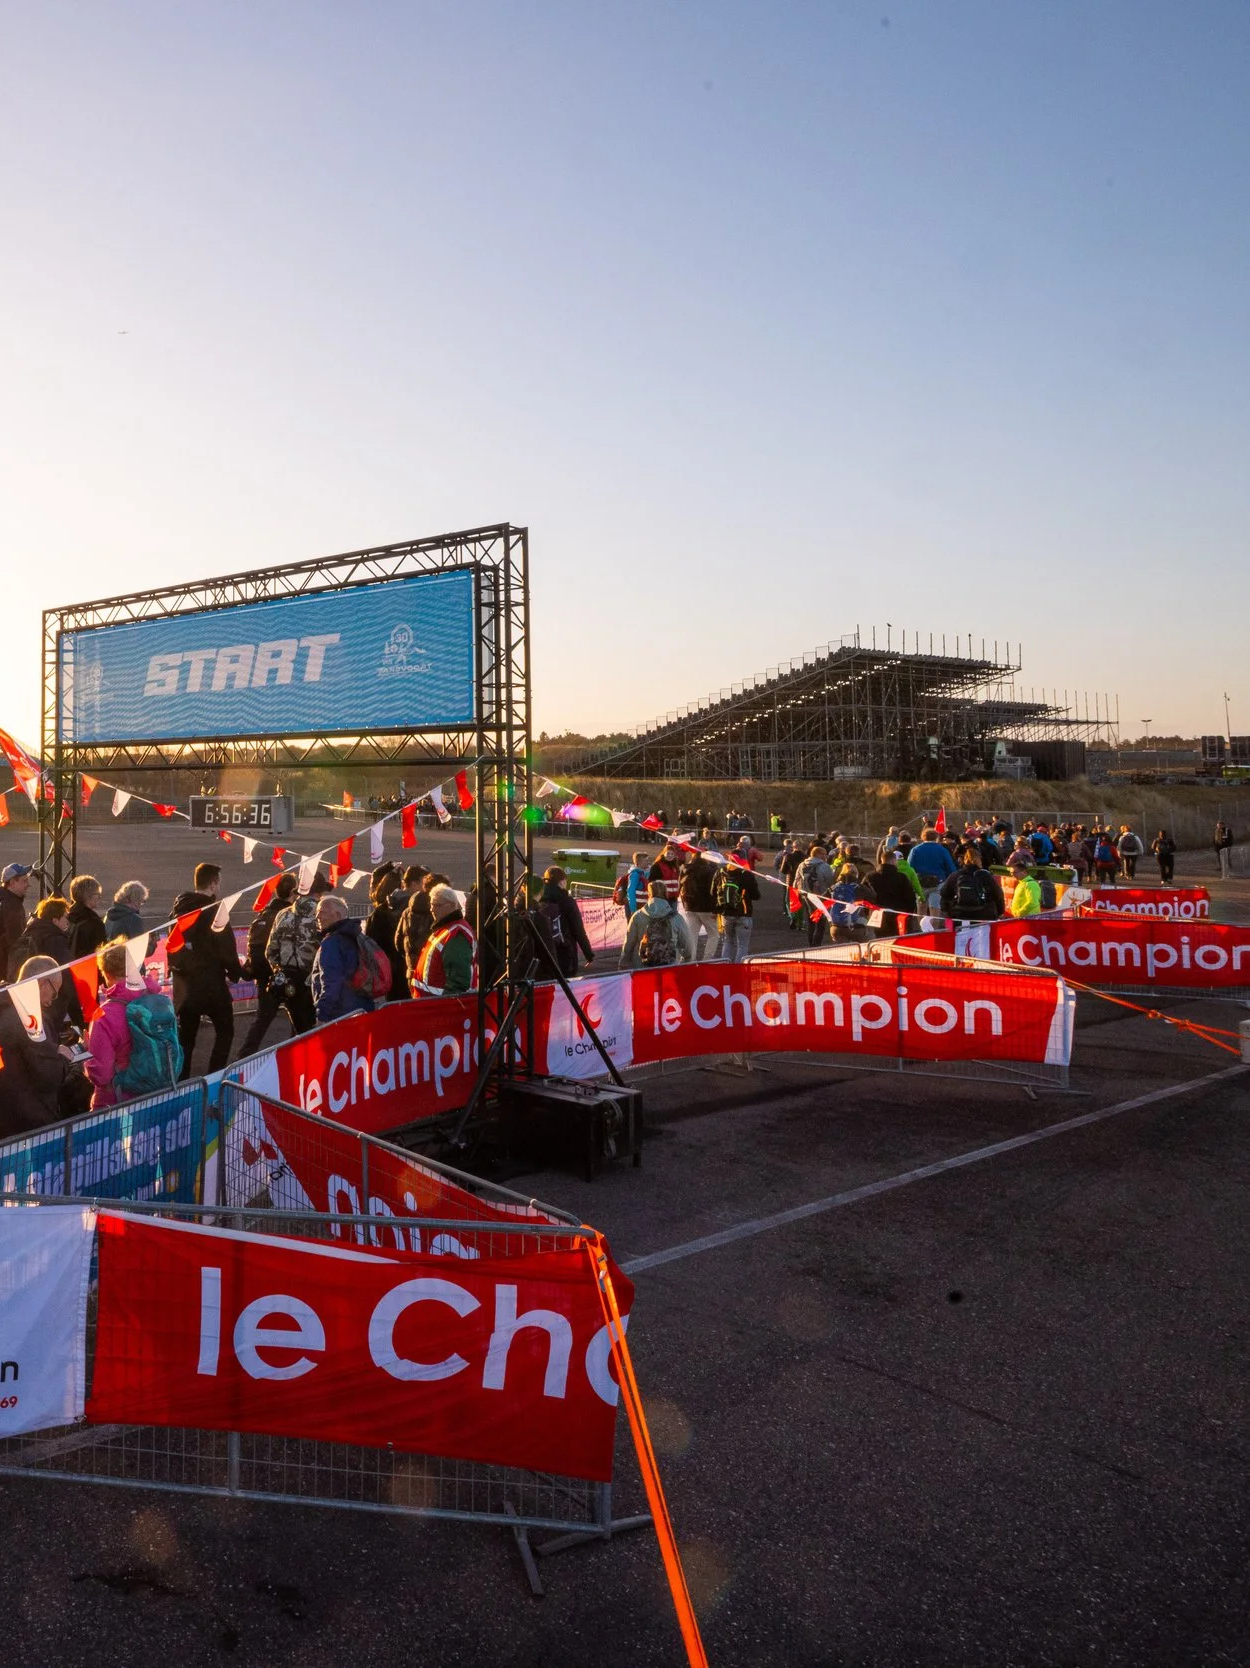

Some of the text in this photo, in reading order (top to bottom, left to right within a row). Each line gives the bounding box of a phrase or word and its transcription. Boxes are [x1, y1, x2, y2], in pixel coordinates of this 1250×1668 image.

[143, 632, 342, 697] START
[204, 803, 271, 825] 6:56:36
[653, 984, 1003, 1042] le Champion
[299, 1073, 323, 1115] le
[197, 1266, 326, 1381] le
